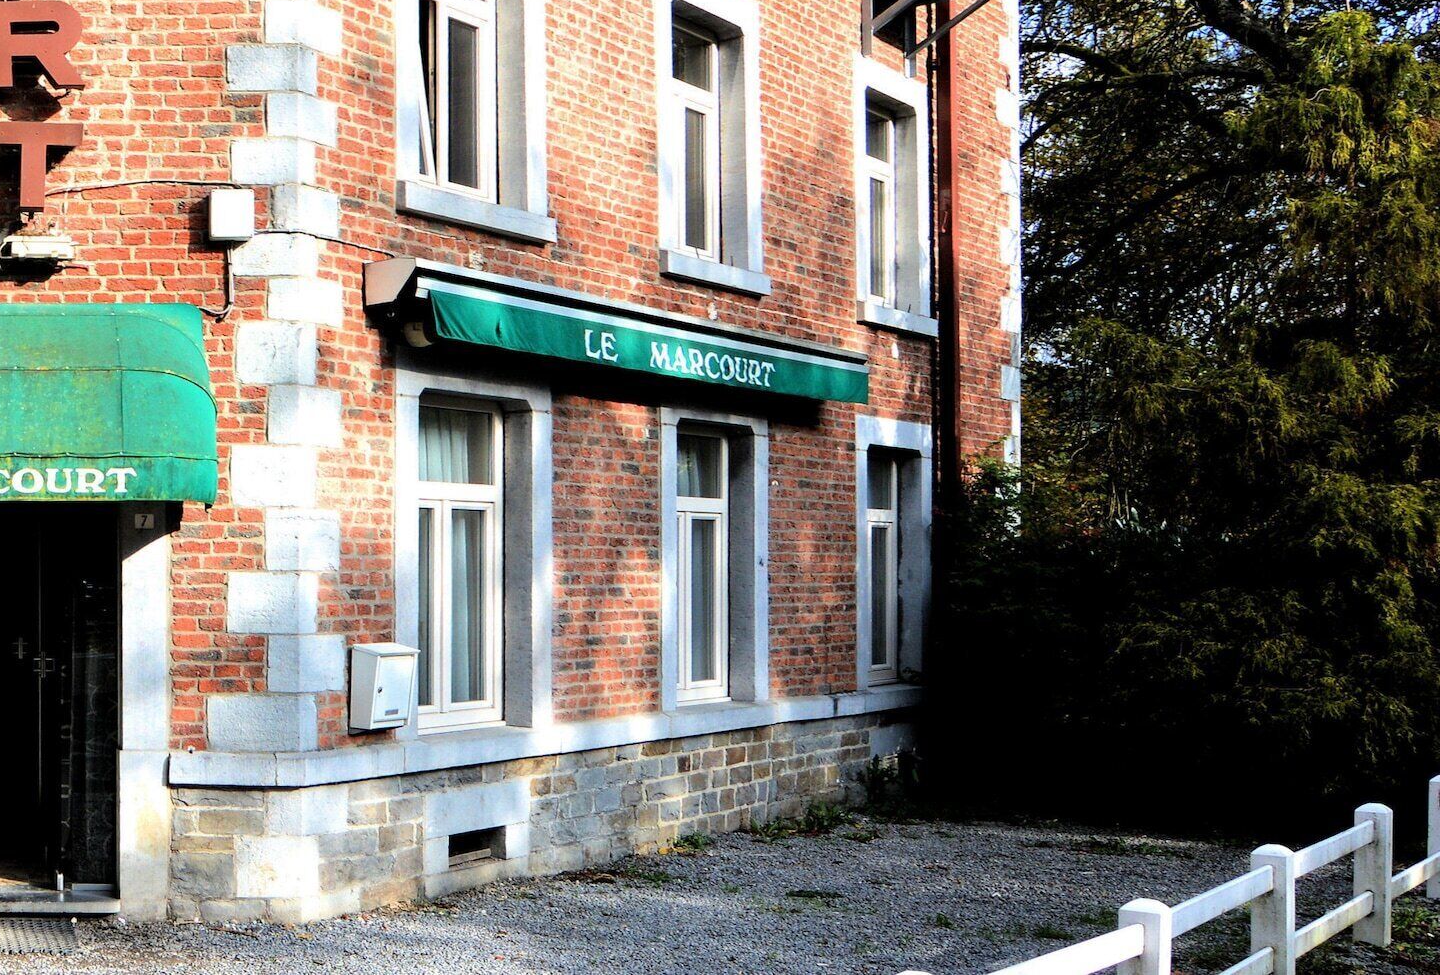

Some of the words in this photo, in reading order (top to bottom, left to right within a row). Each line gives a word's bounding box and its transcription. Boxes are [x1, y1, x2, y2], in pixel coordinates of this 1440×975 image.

[584, 329, 619, 362] LE
[650, 341, 776, 387] MARCOURT
[141, 514, 148, 527] 7
